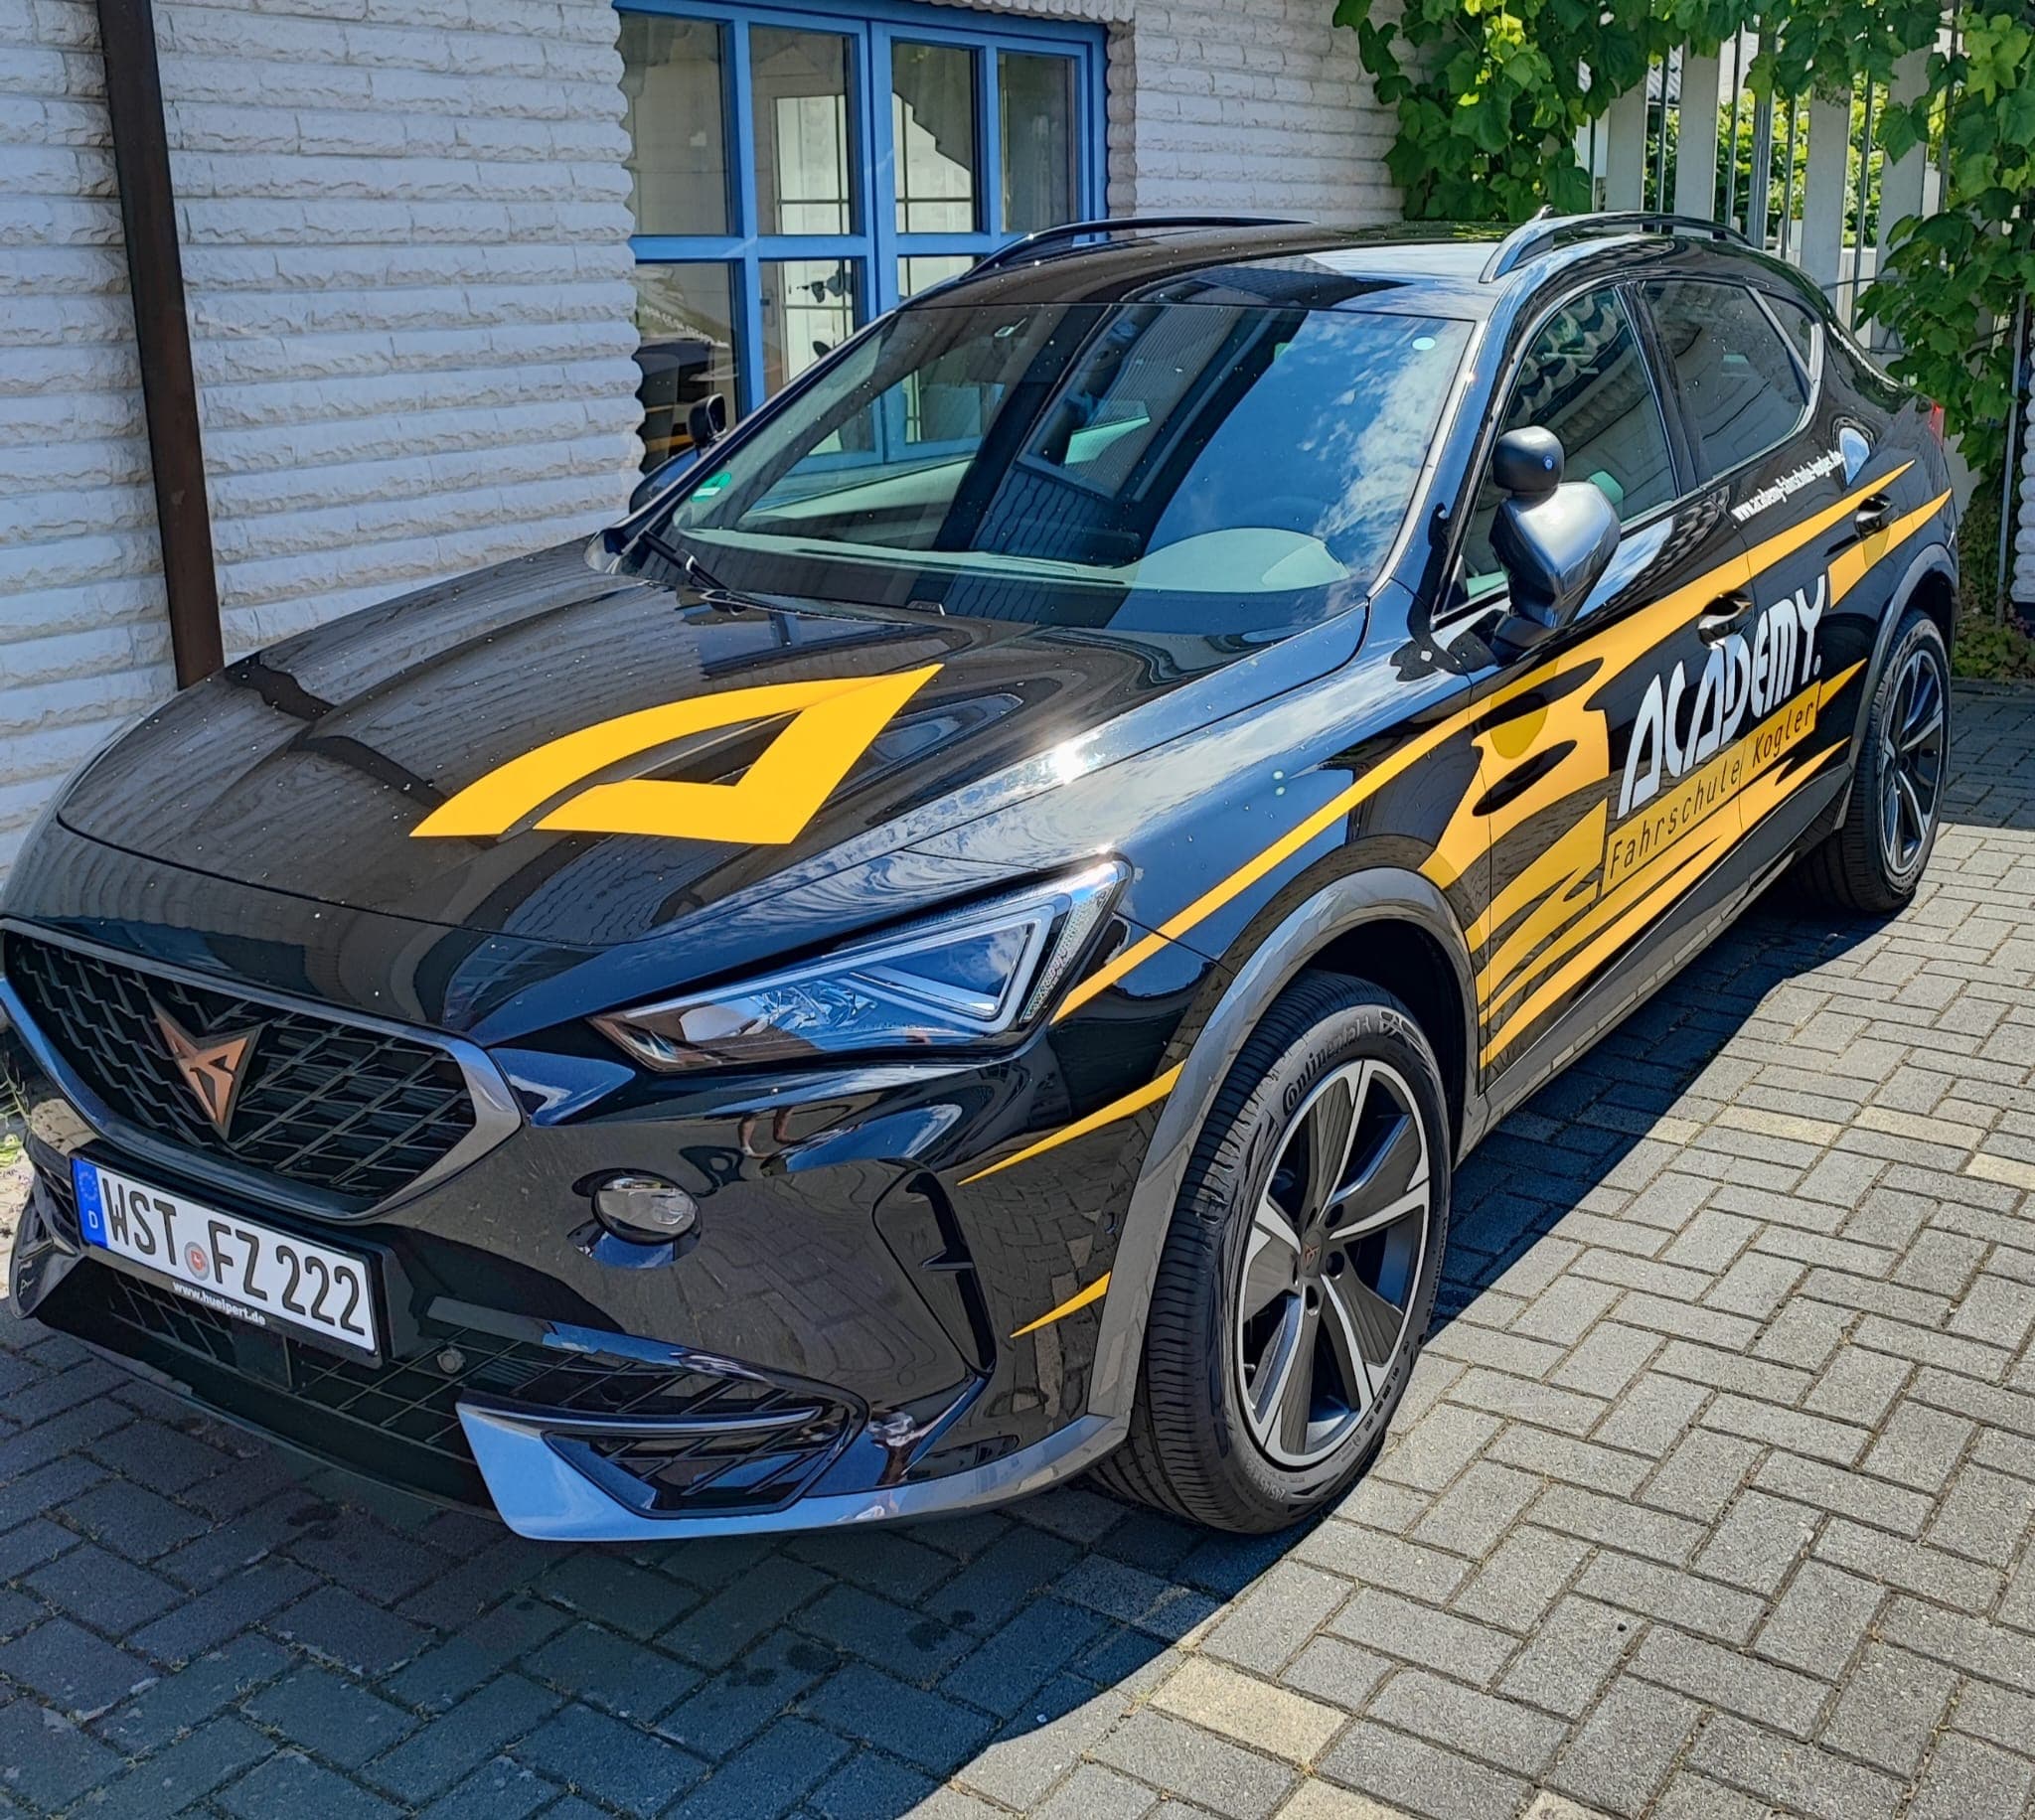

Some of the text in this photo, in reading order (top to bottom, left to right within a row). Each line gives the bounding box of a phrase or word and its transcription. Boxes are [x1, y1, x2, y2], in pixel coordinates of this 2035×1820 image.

[1610, 701, 1813, 879] Fahrschule Kogler
[88, 1209, 98, 1230] D
[102, 1177, 366, 1336] WST FZ 222
[172, 1282, 265, 1325] www.huelpert.de
